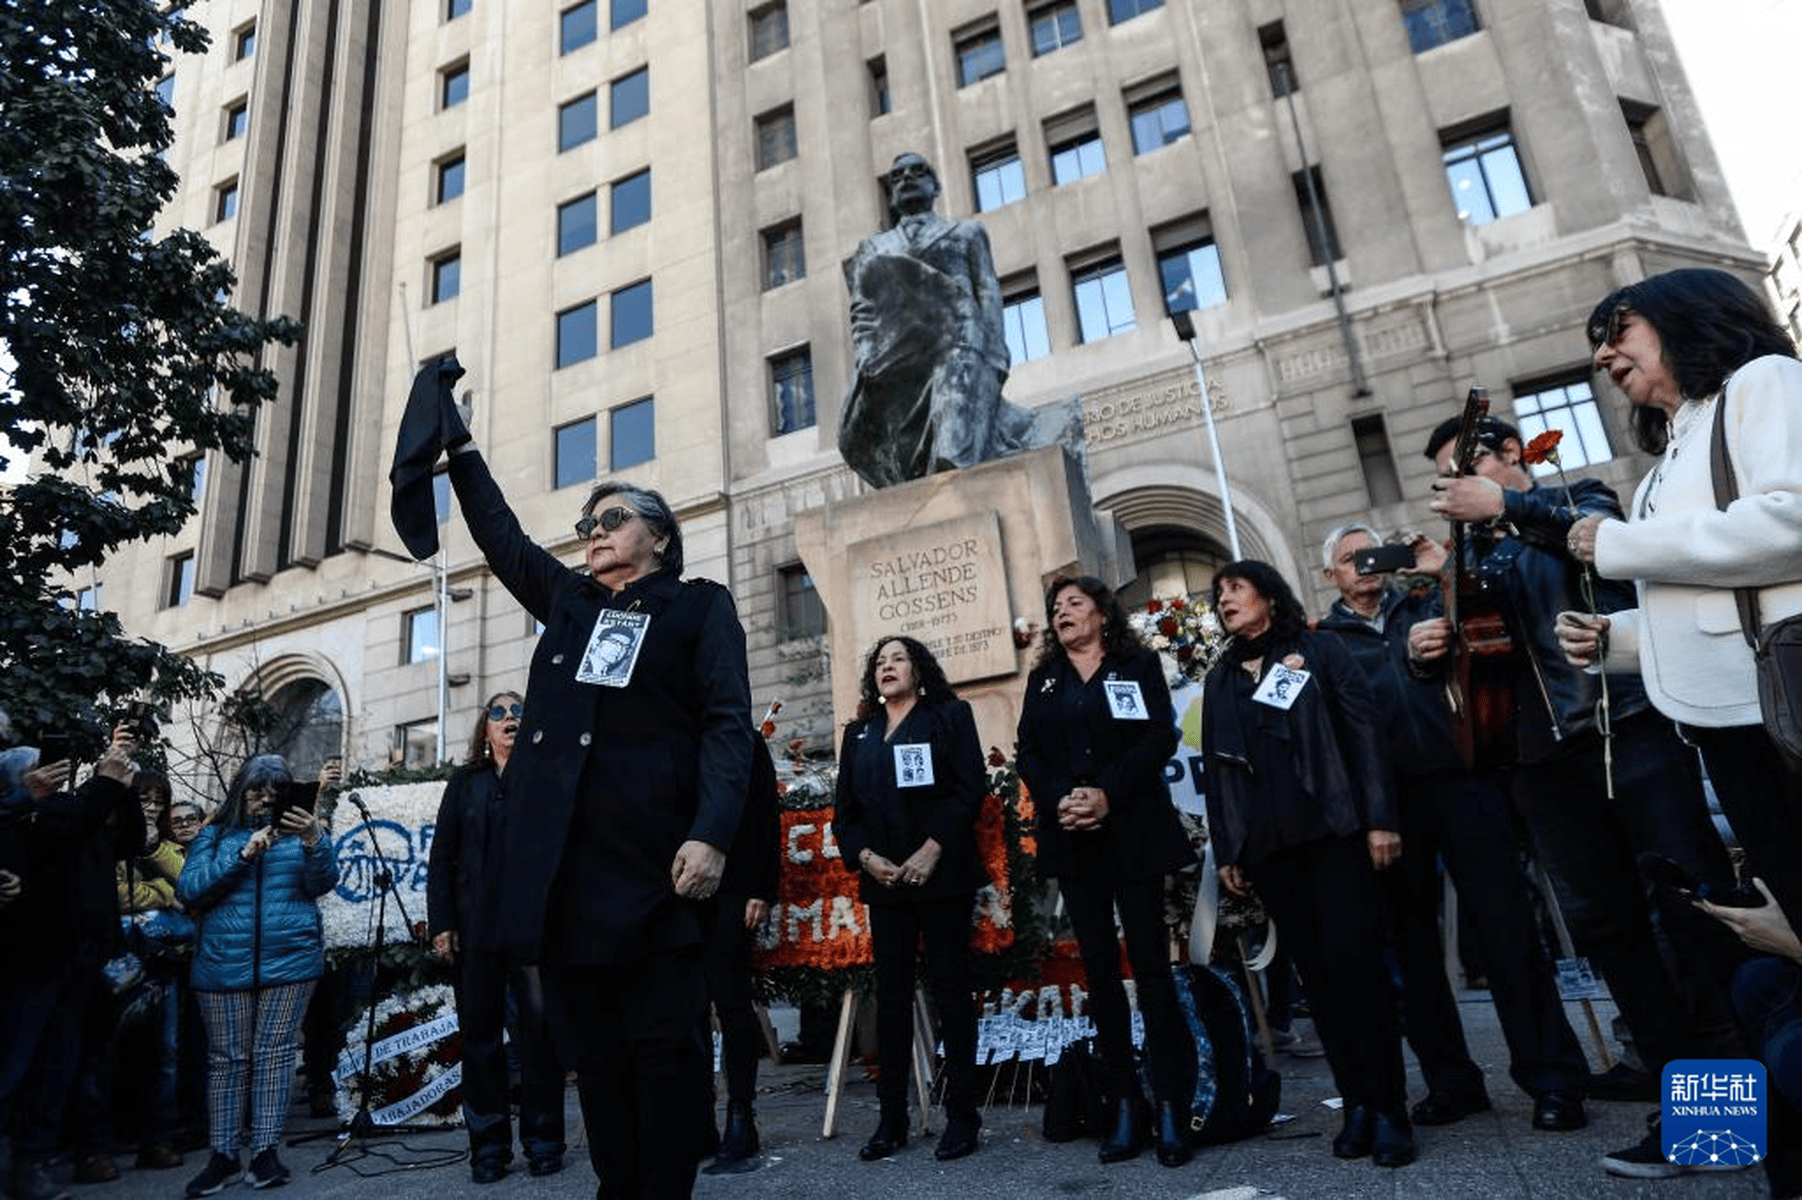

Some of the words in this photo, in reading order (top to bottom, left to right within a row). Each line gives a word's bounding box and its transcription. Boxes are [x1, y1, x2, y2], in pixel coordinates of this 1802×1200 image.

[1144, 378, 1222, 410] JUSTICA
[870, 539, 977, 578] SALVADOR
[877, 562, 977, 600] ALLENDE
[879, 586, 977, 620] GOSSENS
[375, 1042, 392, 1057] DE
[394, 1020, 456, 1050] TRABAJA
